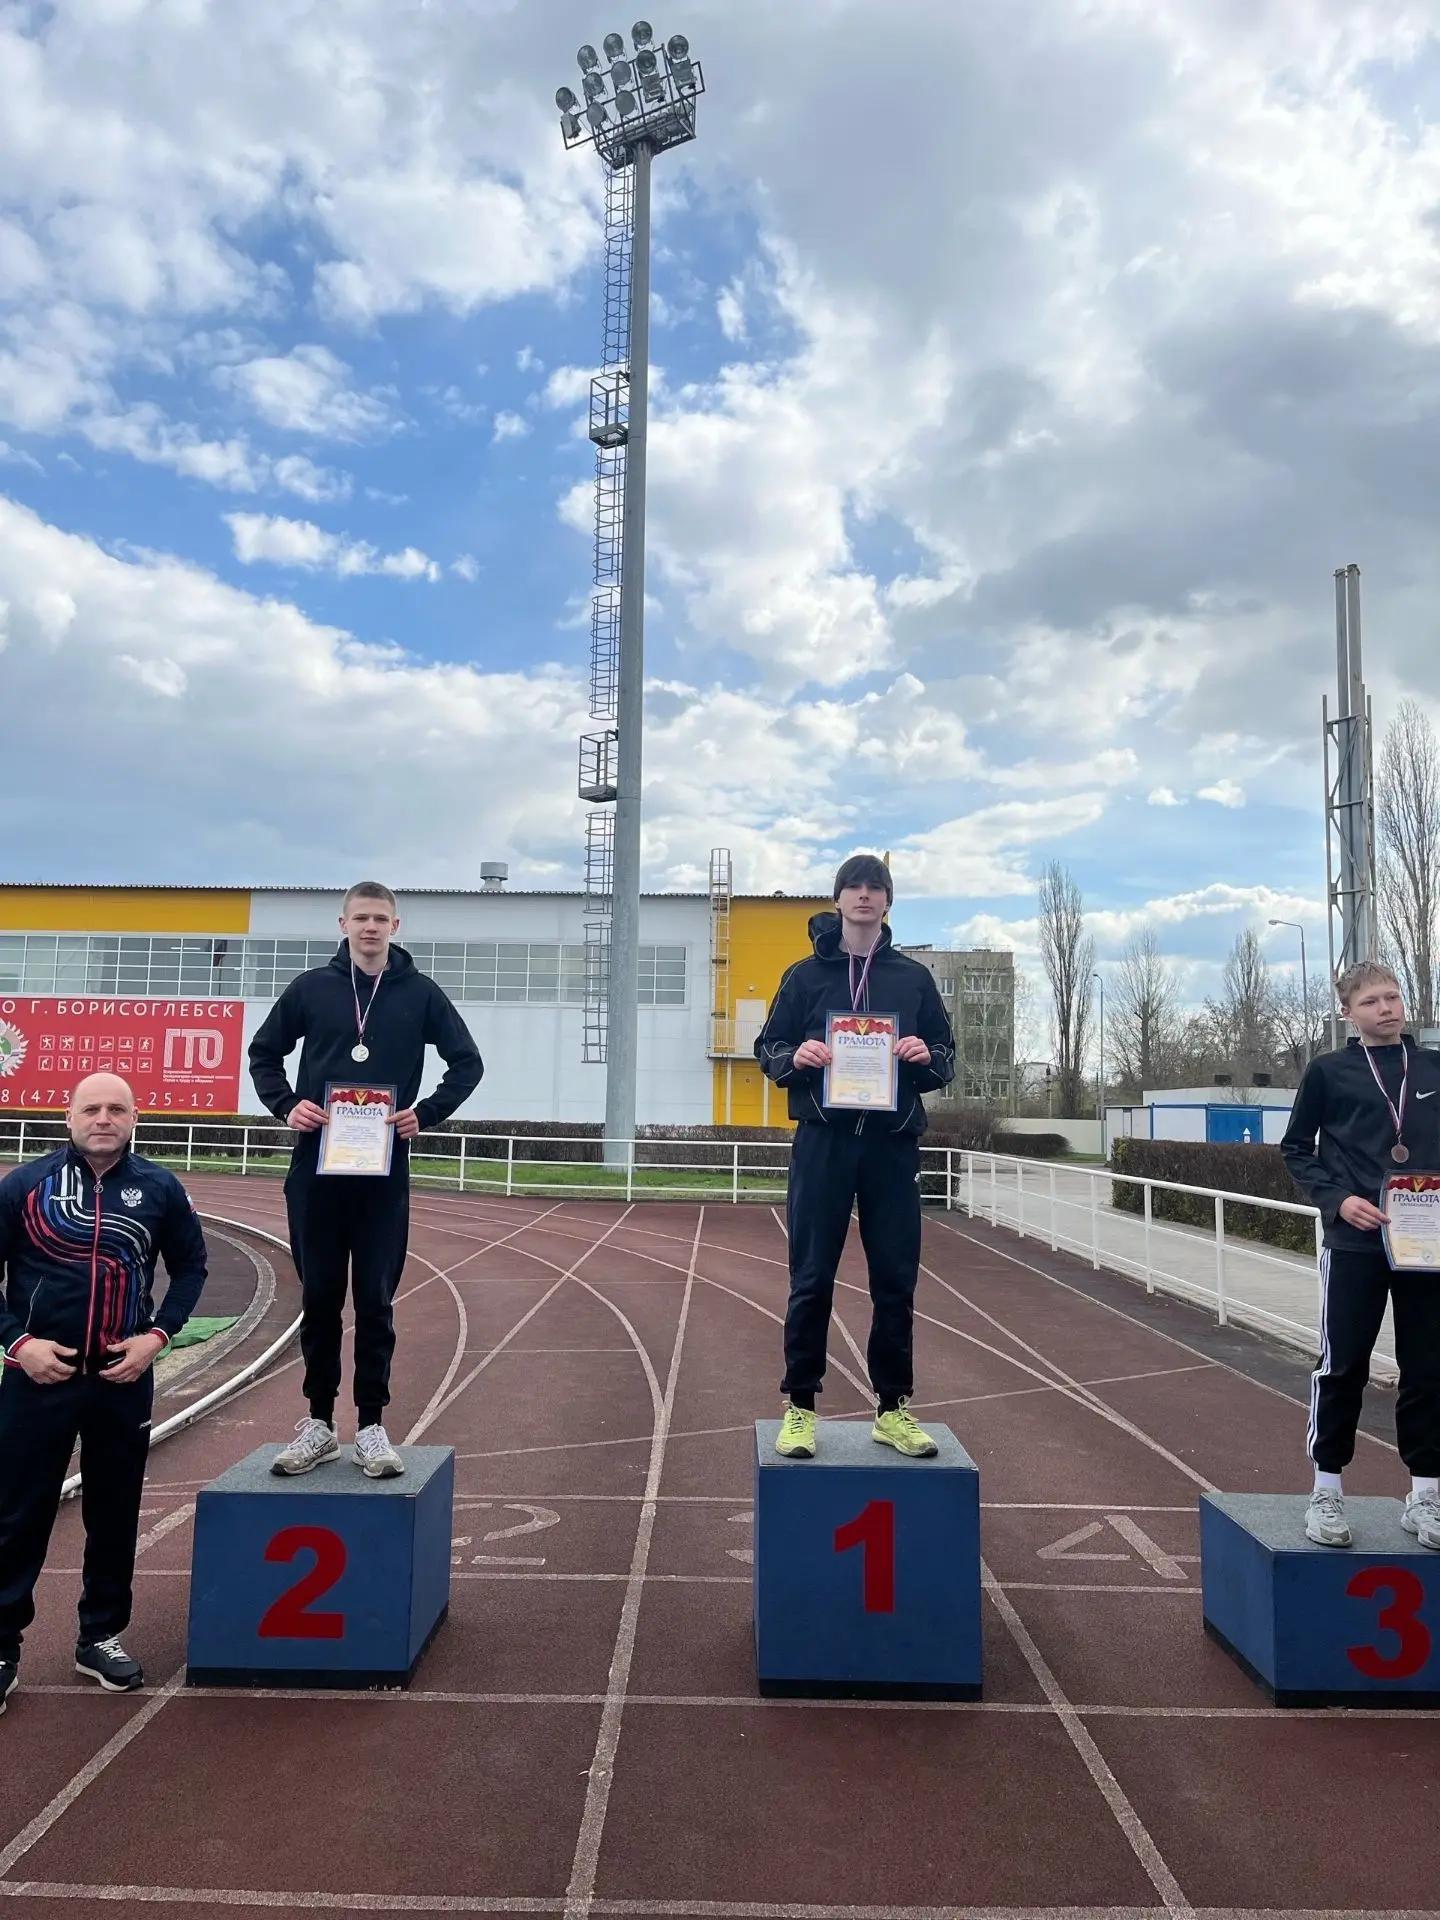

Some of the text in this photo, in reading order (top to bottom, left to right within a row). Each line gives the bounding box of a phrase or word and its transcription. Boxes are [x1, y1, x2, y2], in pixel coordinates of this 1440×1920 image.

[57, 1001, 234, 1018] БОРИСОГЛЕБСК
[163, 1028, 224, 1069] ГТО
[839, 1036, 886, 1046] ГРАМОТА
[20, 1089, 70, 1106] (473
[336, 1106, 383, 1116] ГРАМОТА
[1392, 1193, 1440, 1204] ГРАМОТА
[834, 1499, 895, 1615] 1
[257, 1524, 348, 1640] 2
[1345, 1565, 1432, 1680] 3
